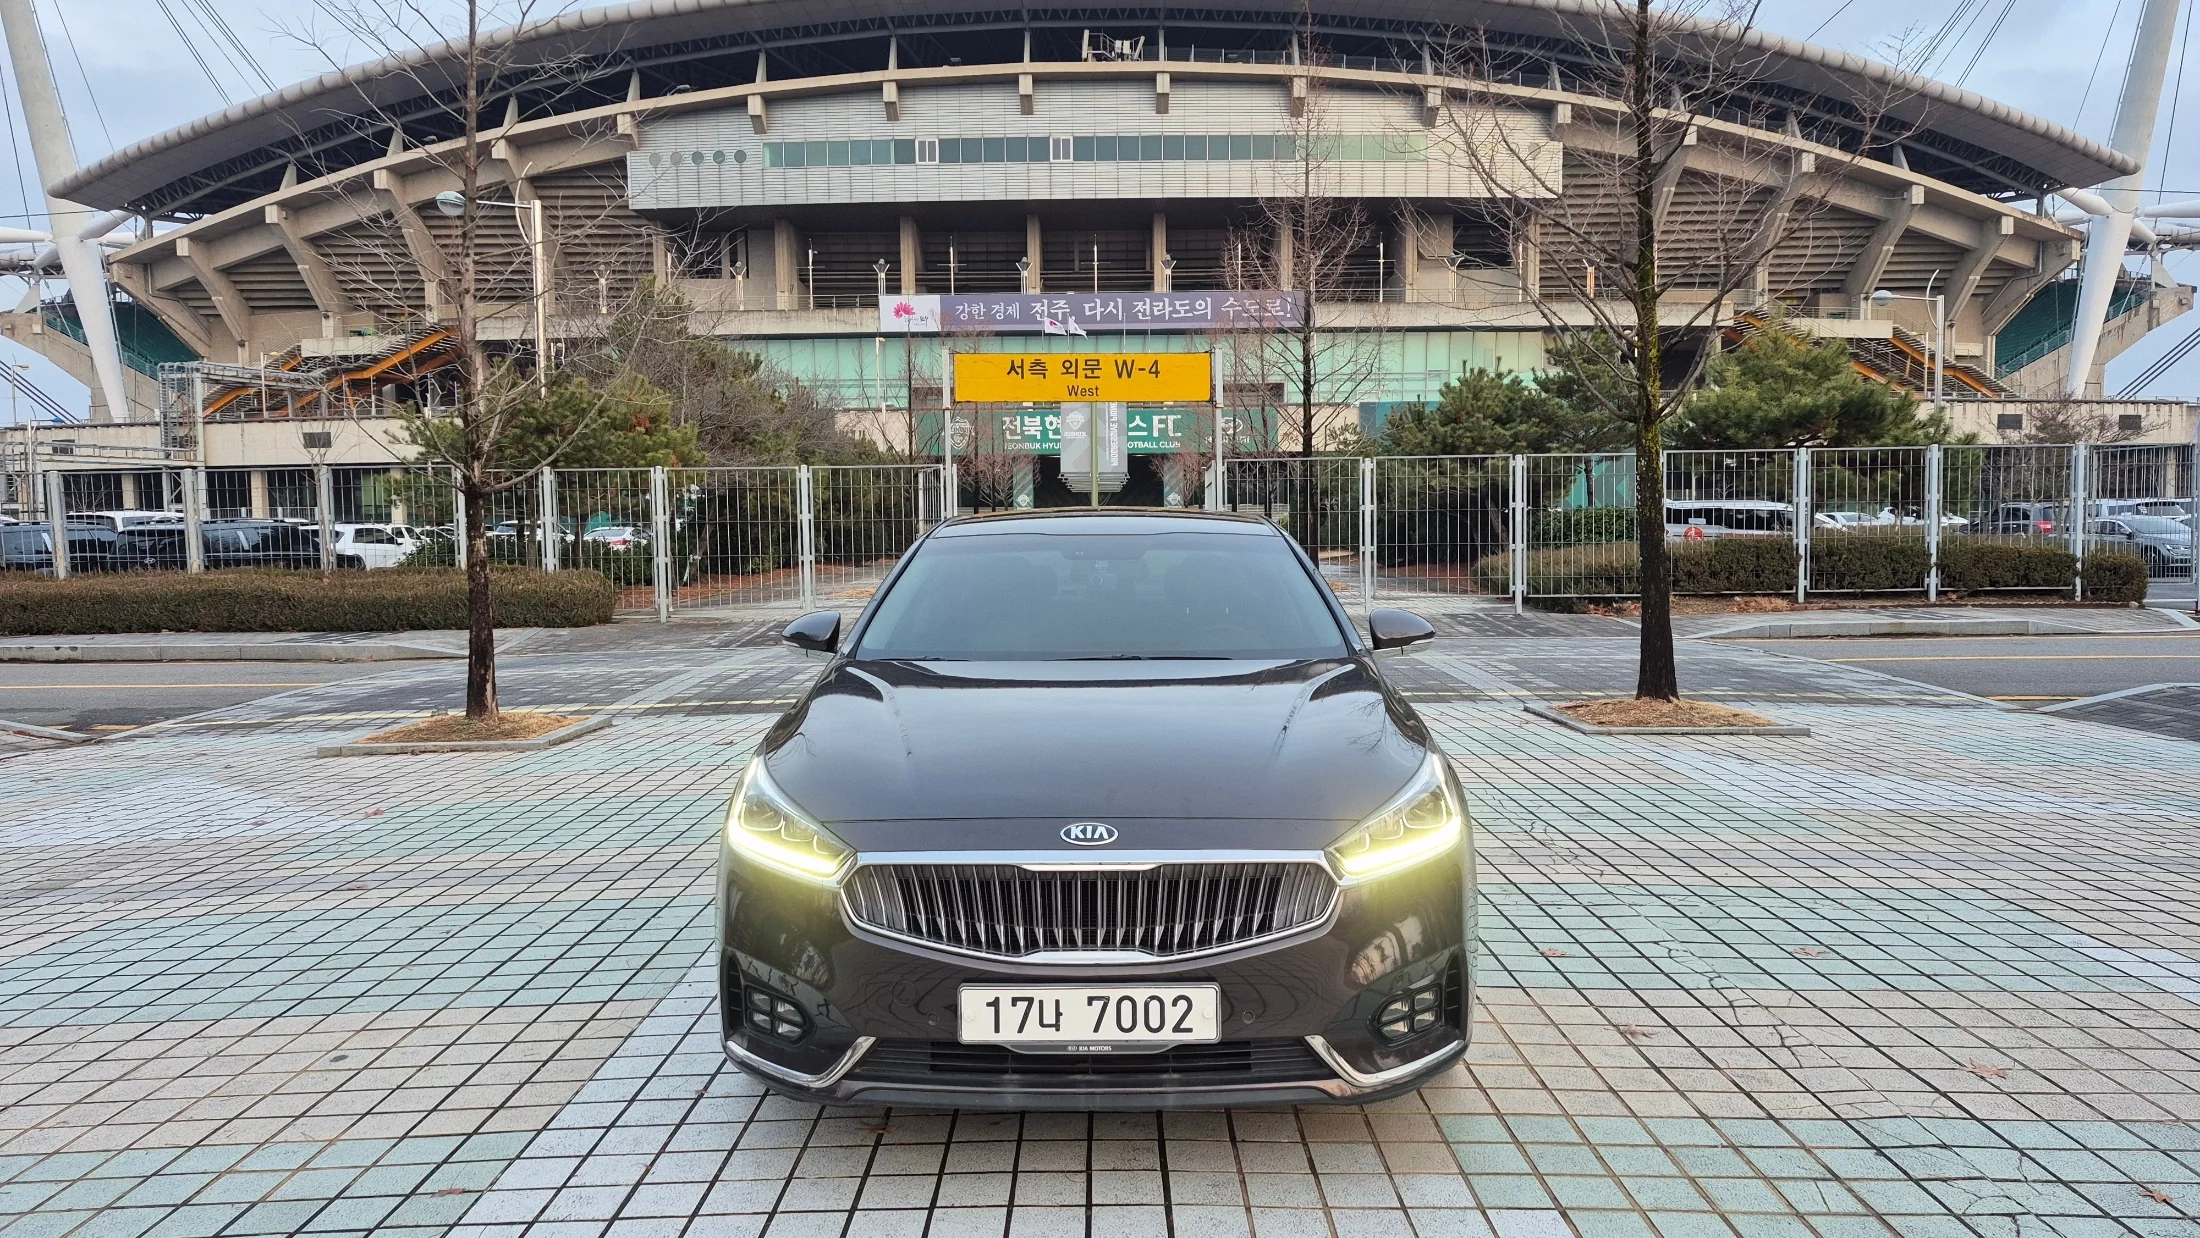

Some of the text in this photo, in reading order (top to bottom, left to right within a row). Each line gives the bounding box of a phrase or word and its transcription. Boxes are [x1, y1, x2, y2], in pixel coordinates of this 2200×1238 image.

[955, 302, 986, 321] 강한
[991, 302, 1020, 320] 경제
[1083, 298, 1122, 321] 다시
[1132, 297, 1212, 321] 전라도의
[1006, 358, 1160, 379] 서측 외문 W-4
[1067, 385, 1099, 397] West
[1070, 825, 1109, 839] KIA
[985, 994, 1194, 1034] 17나 7002
